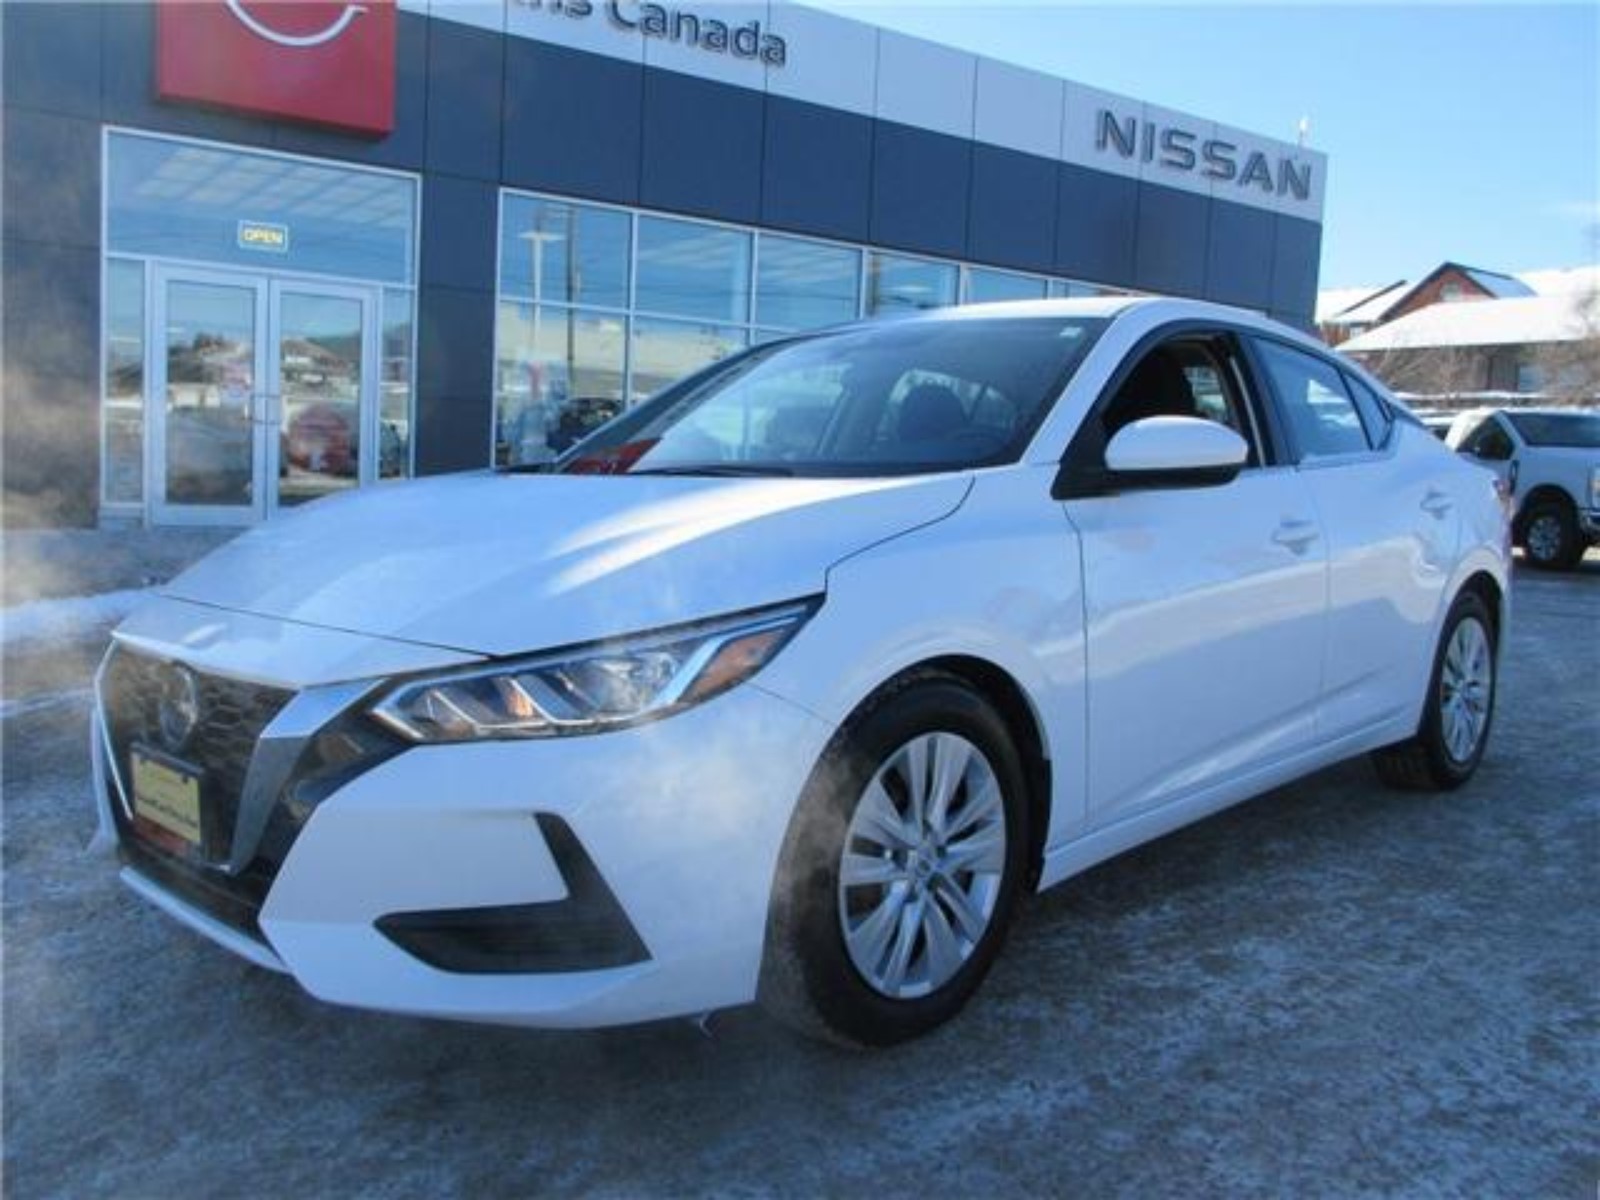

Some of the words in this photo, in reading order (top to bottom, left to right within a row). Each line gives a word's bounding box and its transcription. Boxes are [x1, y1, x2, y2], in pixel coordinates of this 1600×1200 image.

[607, 0, 787, 65] Canada
[1095, 108, 1311, 201] NISSAN
[244, 228, 283, 244] OPEN
